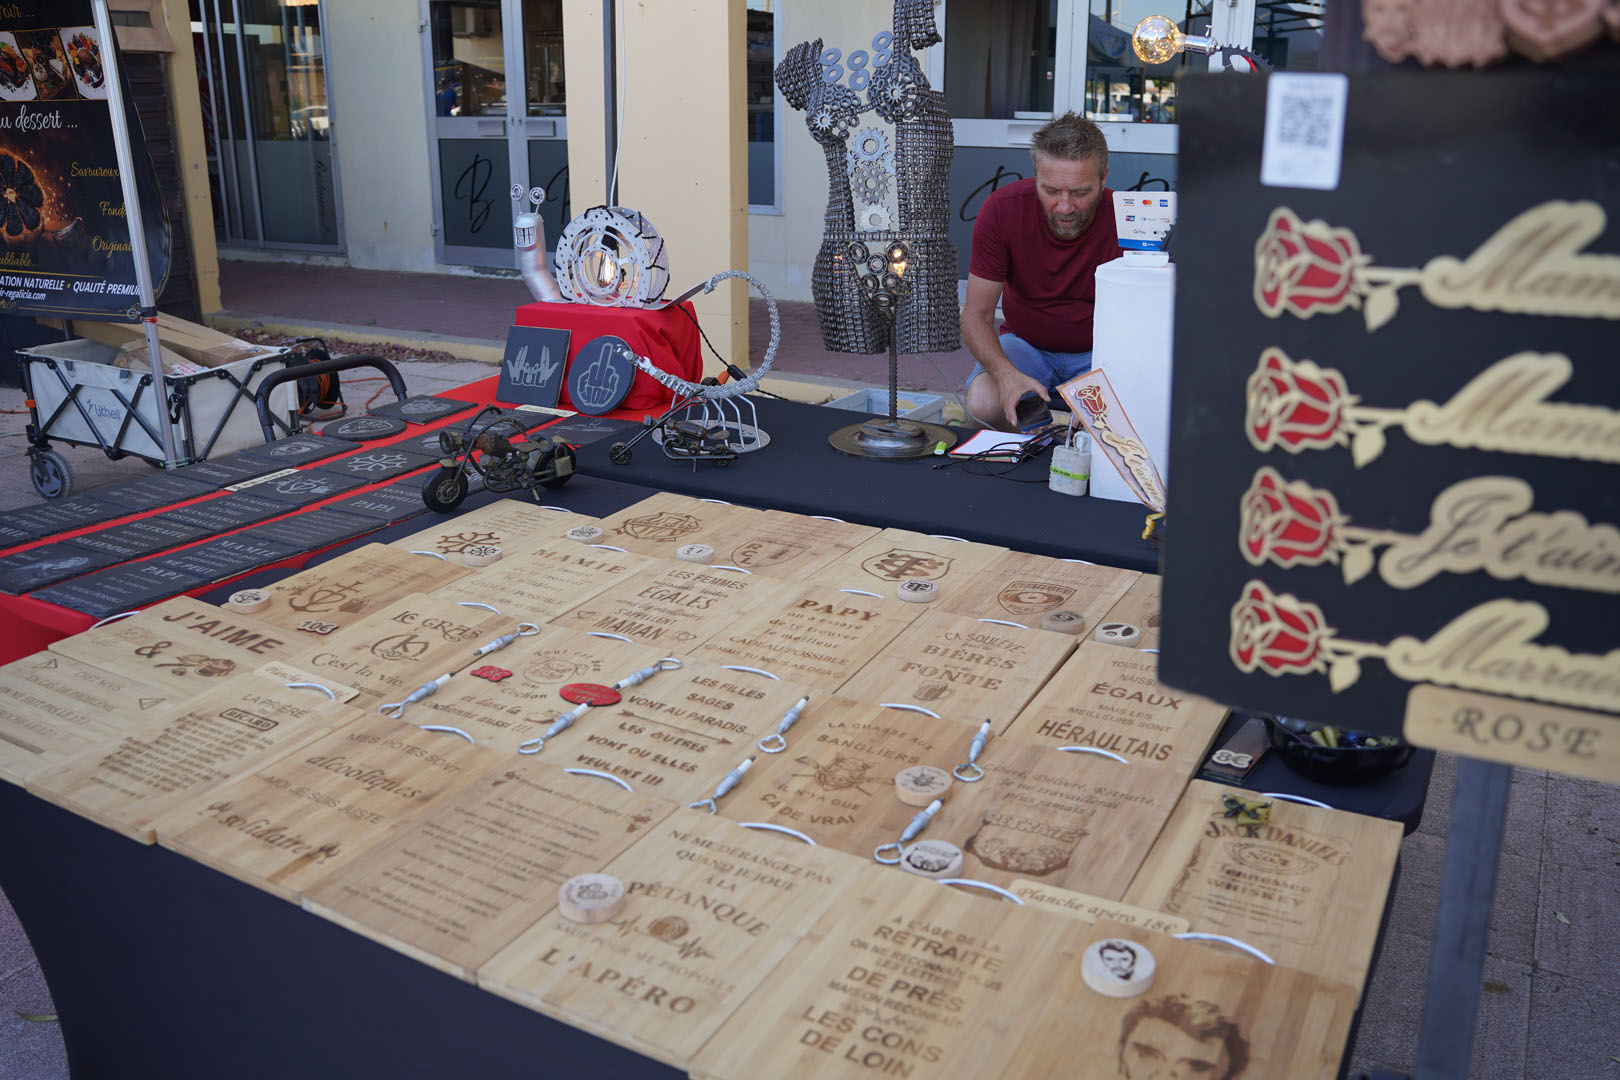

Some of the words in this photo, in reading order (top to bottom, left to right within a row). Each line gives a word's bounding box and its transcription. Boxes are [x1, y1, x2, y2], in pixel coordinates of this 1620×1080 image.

[15, 104, 62, 133] dessert
[71, 161, 120, 178] Savoureux
[23, 279, 65, 291] NATURELLE
[73, 280, 106, 294] QUALITÉ
[1395, 493, 1516, 574] Je
[216, 539, 282, 558] MAMIE
[531, 549, 627, 575] MAMIE
[668, 569, 695, 581] LES
[693, 574, 749, 590] FEMMES
[637, 585, 719, 610] ÉGALES
[795, 599, 881, 622] PAPY
[163, 610, 286, 656] J'AIME
[592, 615, 670, 641] MAMAN
[135, 640, 173, 658] &
[921, 644, 1017, 670] BIÈRES
[899, 661, 1004, 692] FONTE
[1111, 660, 1138, 670] TOUS
[692, 675, 718, 688] LES
[718, 681, 767, 701] FILLES
[1090, 681, 1185, 711] ÉGAUX
[628, 695, 665, 712] VONT
[665, 706, 687, 718] AU
[685, 692, 736, 711] SAGES
[1097, 703, 1127, 714] MAIS
[1129, 709, 1153, 720] LES
[227, 710, 272, 731] RICARD
[617, 721, 649, 735] LES
[828, 721, 849, 730] LA
[850, 722, 909, 740] CHASSE
[1136, 721, 1174, 734] SONT
[1452, 706, 1603, 759] ROSE
[816, 733, 922, 766] SANGLIERS
[1036, 719, 1174, 762] HÉRAULTAIS
[587, 734, 629, 749] VONT
[651, 754, 700, 774] ELLES
[1215, 751, 1251, 767] 8€
[306, 755, 423, 799] alcooliques
[576, 753, 643, 780] VEULENT
[641, 772, 666, 787] !!!
[1002, 792, 1036, 804] plus
[778, 806, 804, 821] DE
[808, 814, 856, 825] VRAI
[1205, 821, 1261, 840] JACK
[667, 829, 689, 841] NE
[690, 836, 715, 850] ME
[718, 841, 803, 876] DÉRANGEZ
[676, 848, 736, 875] QUAND
[735, 868, 754, 883] JE
[750, 872, 799, 893] JOUE
[1207, 877, 1305, 908] WHISKEY
[625, 879, 771, 937] PÉTANQUE
[1016, 886, 1086, 914] Planche
[1086, 902, 1137, 925] apéro
[1142, 918, 1179, 932] 18€
[849, 937, 872, 950] ON
[872, 924, 1005, 975] RETRAITE
[956, 933, 979, 946] DE
[979, 942, 1002, 954] LA
[538, 947, 698, 1016] L'APÉRO
[874, 956, 901, 972] LES
[901, 964, 963, 991] LETTRES
[846, 965, 888, 988] DE
[889, 977, 967, 1014] PRÈS
[801, 1004, 858, 1035] LES
[861, 1025, 945, 1064] CONS
[799, 1029, 843, 1055] DE
[844, 1044, 917, 1080] LOIN
